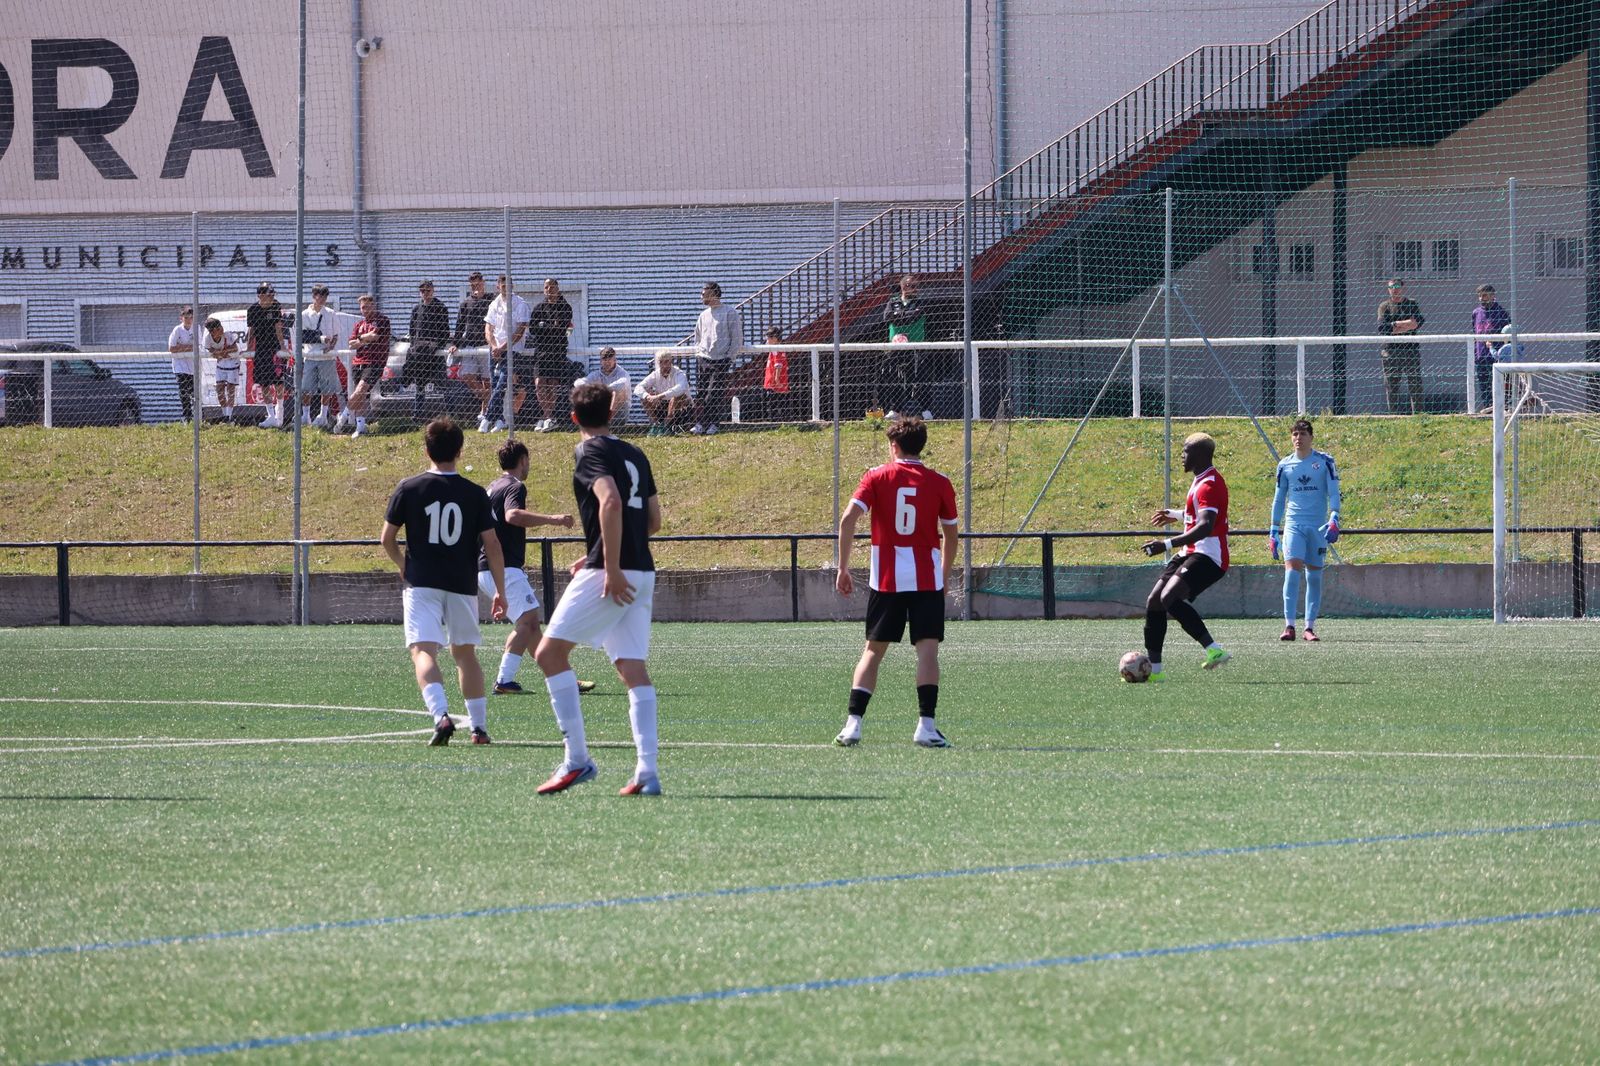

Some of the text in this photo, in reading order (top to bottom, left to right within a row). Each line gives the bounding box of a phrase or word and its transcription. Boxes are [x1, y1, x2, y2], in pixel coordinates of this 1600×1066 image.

[0, 36, 276, 180] RA
[624, 459, 643, 509] 2
[424, 500, 463, 546] 10
[895, 487, 917, 535] 6
